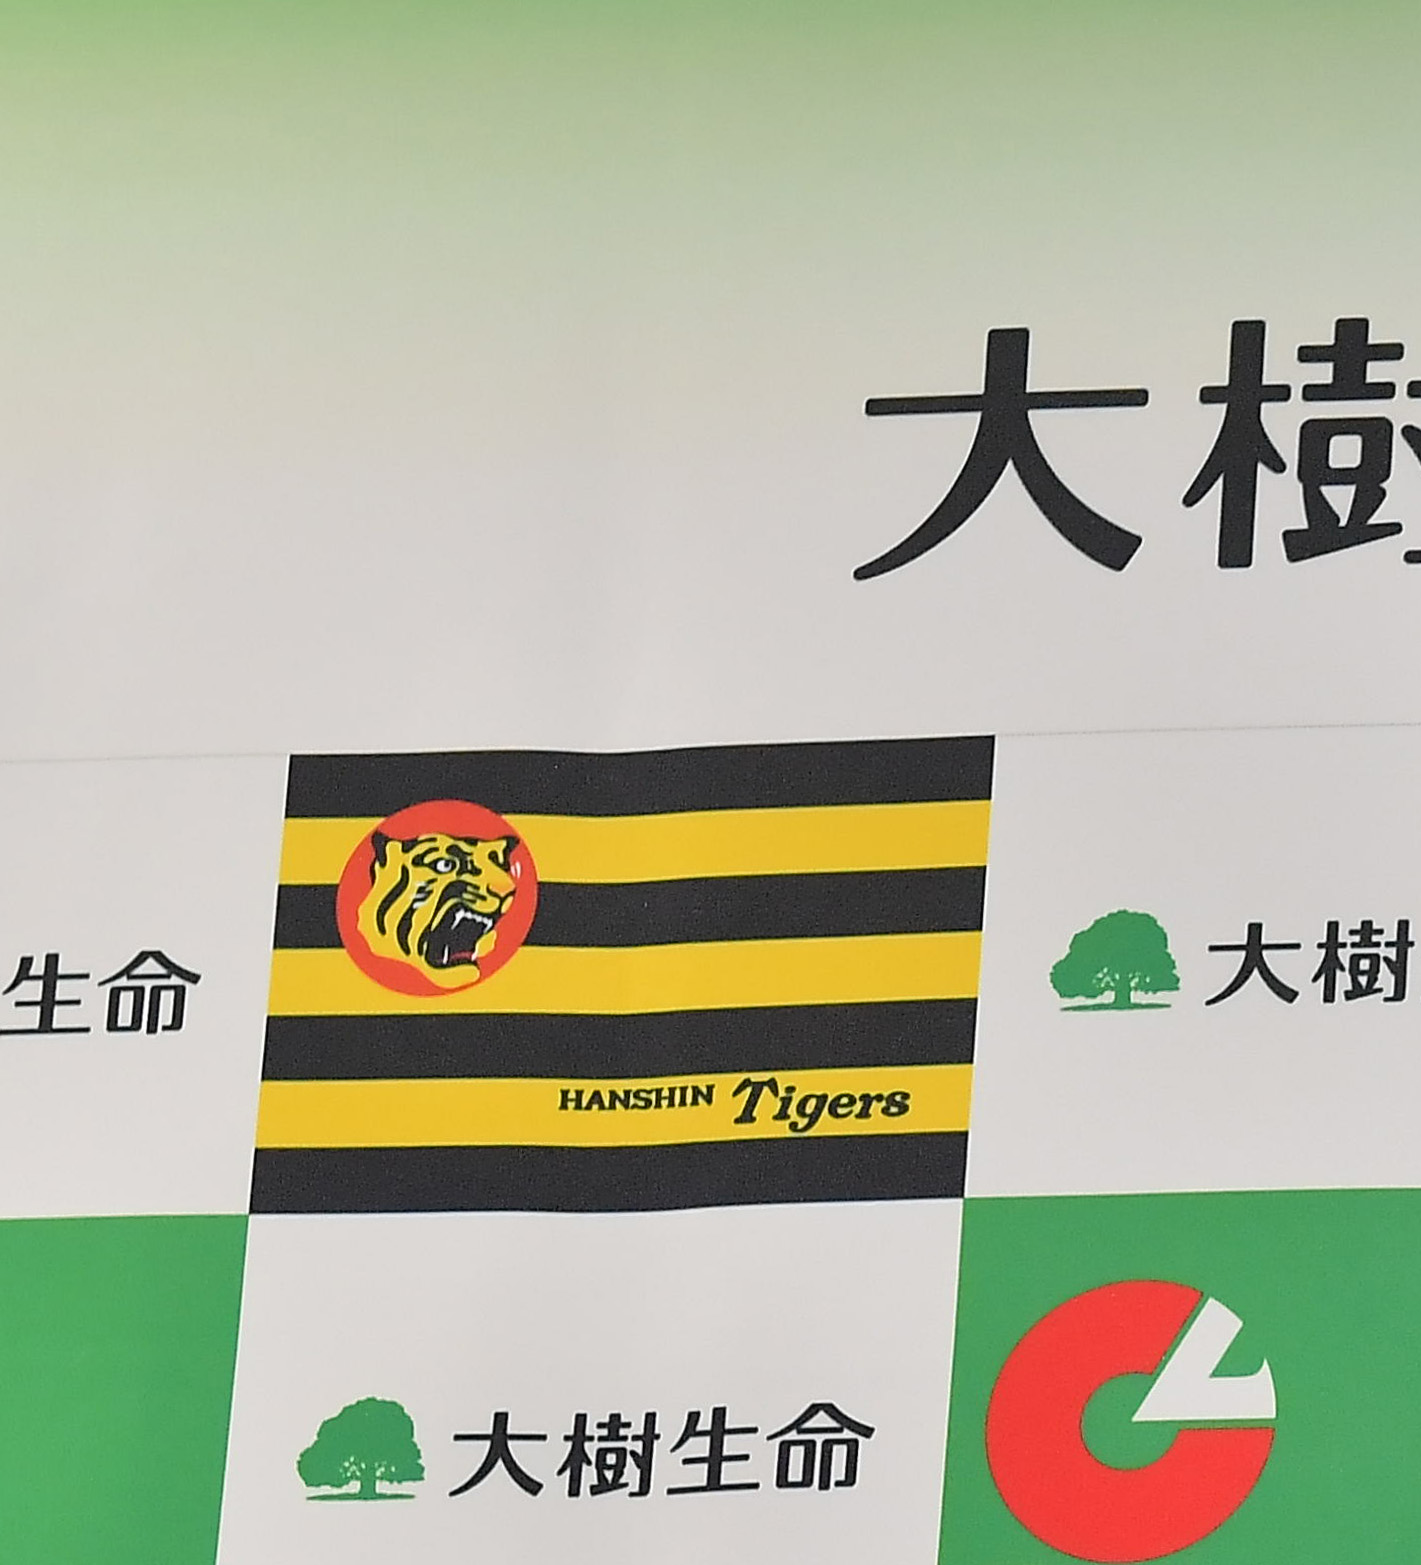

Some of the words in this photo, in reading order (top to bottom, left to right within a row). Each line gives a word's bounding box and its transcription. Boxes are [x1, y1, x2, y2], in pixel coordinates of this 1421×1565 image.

[559, 1083, 716, 1113] HANSHIN
[731, 1077, 912, 1134] Tigers
[448, 1402, 876, 1499] 大樹生命
